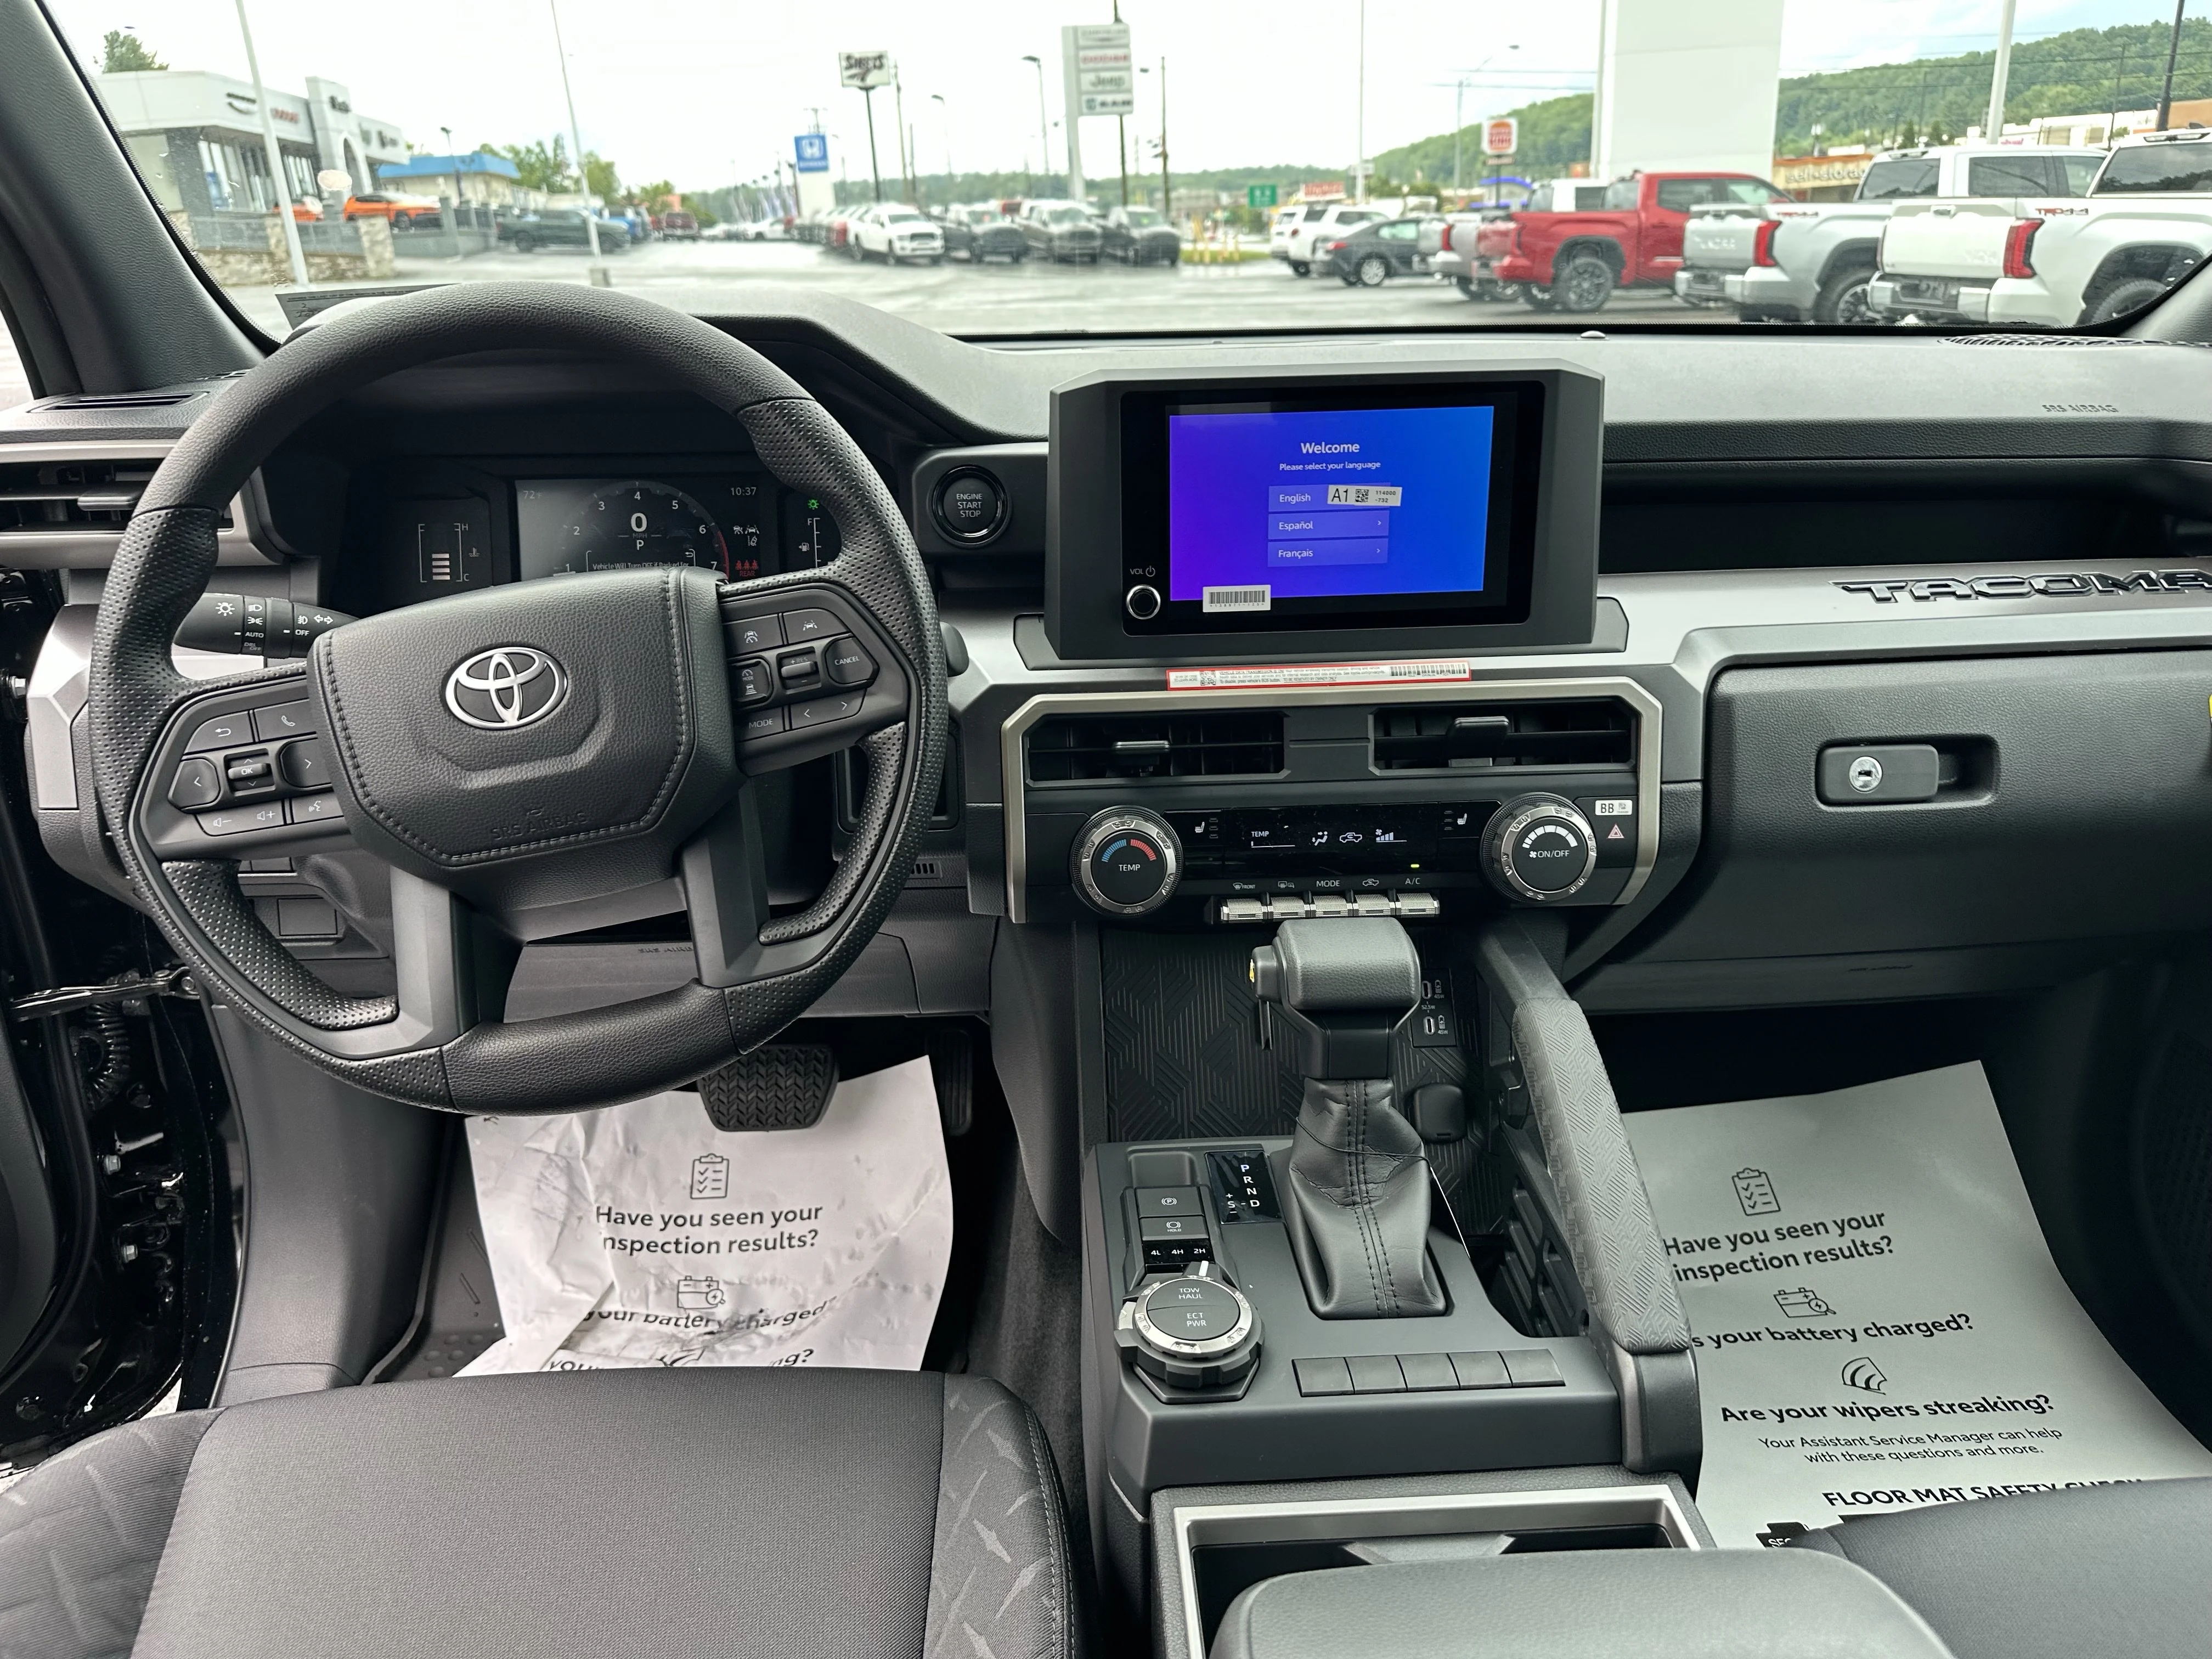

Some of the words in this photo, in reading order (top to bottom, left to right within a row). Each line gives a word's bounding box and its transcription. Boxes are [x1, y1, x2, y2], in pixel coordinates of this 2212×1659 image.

[2068, 404, 2119, 413] AIRBAG
[1300, 441, 1361, 454] Welcome
[1279, 463, 1304, 471] Please
[1305, 462, 1326, 471] select
[1326, 462, 1344, 472] your
[1345, 461, 1381, 470] language
[634, 491, 641, 500] 4
[730, 487, 757, 496] 10:37
[1331, 487, 1349, 503] A1
[1279, 493, 1311, 504] English
[598, 501, 605, 510] 3
[672, 500, 679, 510] 5
[630, 512, 647, 532] 0
[807, 518, 812, 526] F
[1279, 521, 1314, 532] Español
[573, 526, 580, 535] 2
[698, 524, 707, 534] 6
[636, 539, 645, 550] P
[1278, 549, 1314, 560] Français
[565, 563, 571, 572] 1
[592, 562, 614, 571] Vehicle
[710, 561, 718, 570] 7
[464, 573, 470, 582] C
[834, 656, 860, 665] CANCEL
[748, 718, 774, 729] MODE
[240, 767, 253, 776] OK
[1600, 803, 1614, 814] BB
[1537, 849, 1570, 859] ON/OFF
[1118, 864, 1141, 872] TEMP
[1240, 1164, 1250, 1172] P
[596, 1205, 653, 1226] Have
[659, 1214, 703, 1231] you
[710, 1211, 764, 1226] seen
[770, 1206, 823, 1228] your
[1663, 1236, 1722, 1257] Have
[1725, 1229, 1770, 1252] you
[1774, 1220, 1830, 1241] seen
[1832, 1211, 1886, 1238] your
[600, 1231, 721, 1256] nspection
[728, 1228, 819, 1253] results?
[1672, 1252, 1800, 1282] inspection
[1803, 1234, 1894, 1265] results?
[1710, 1330, 1763, 1350] your
[1764, 1326, 1858, 1343] battery
[1863, 1312, 1974, 1338] charged?
[1721, 1406, 1767, 1423] Are
[1769, 1406, 1828, 1424] your
[1832, 1401, 1920, 1422] wipers
[1923, 1394, 2055, 1416] streaking?
[1758, 1437, 1795, 1448] Your
[1799, 1435, 1870, 1447] Assistant
[1869, 1434, 1926, 1446] Service
[1926, 1432, 1995, 1444] Manager
[1997, 1431, 2027, 1440] can
[2024, 1427, 2063, 1440] help
[1804, 1451, 1840, 1463] with
[1841, 1450, 1886, 1462] these
[1888, 1448, 1963, 1462] questions
[1965, 1444, 1997, 1457] and
[1997, 1445, 2045, 1455] more.
[1822, 1489, 1911, 1506] FLOOR
[1911, 1487, 1967, 1504] MAT
